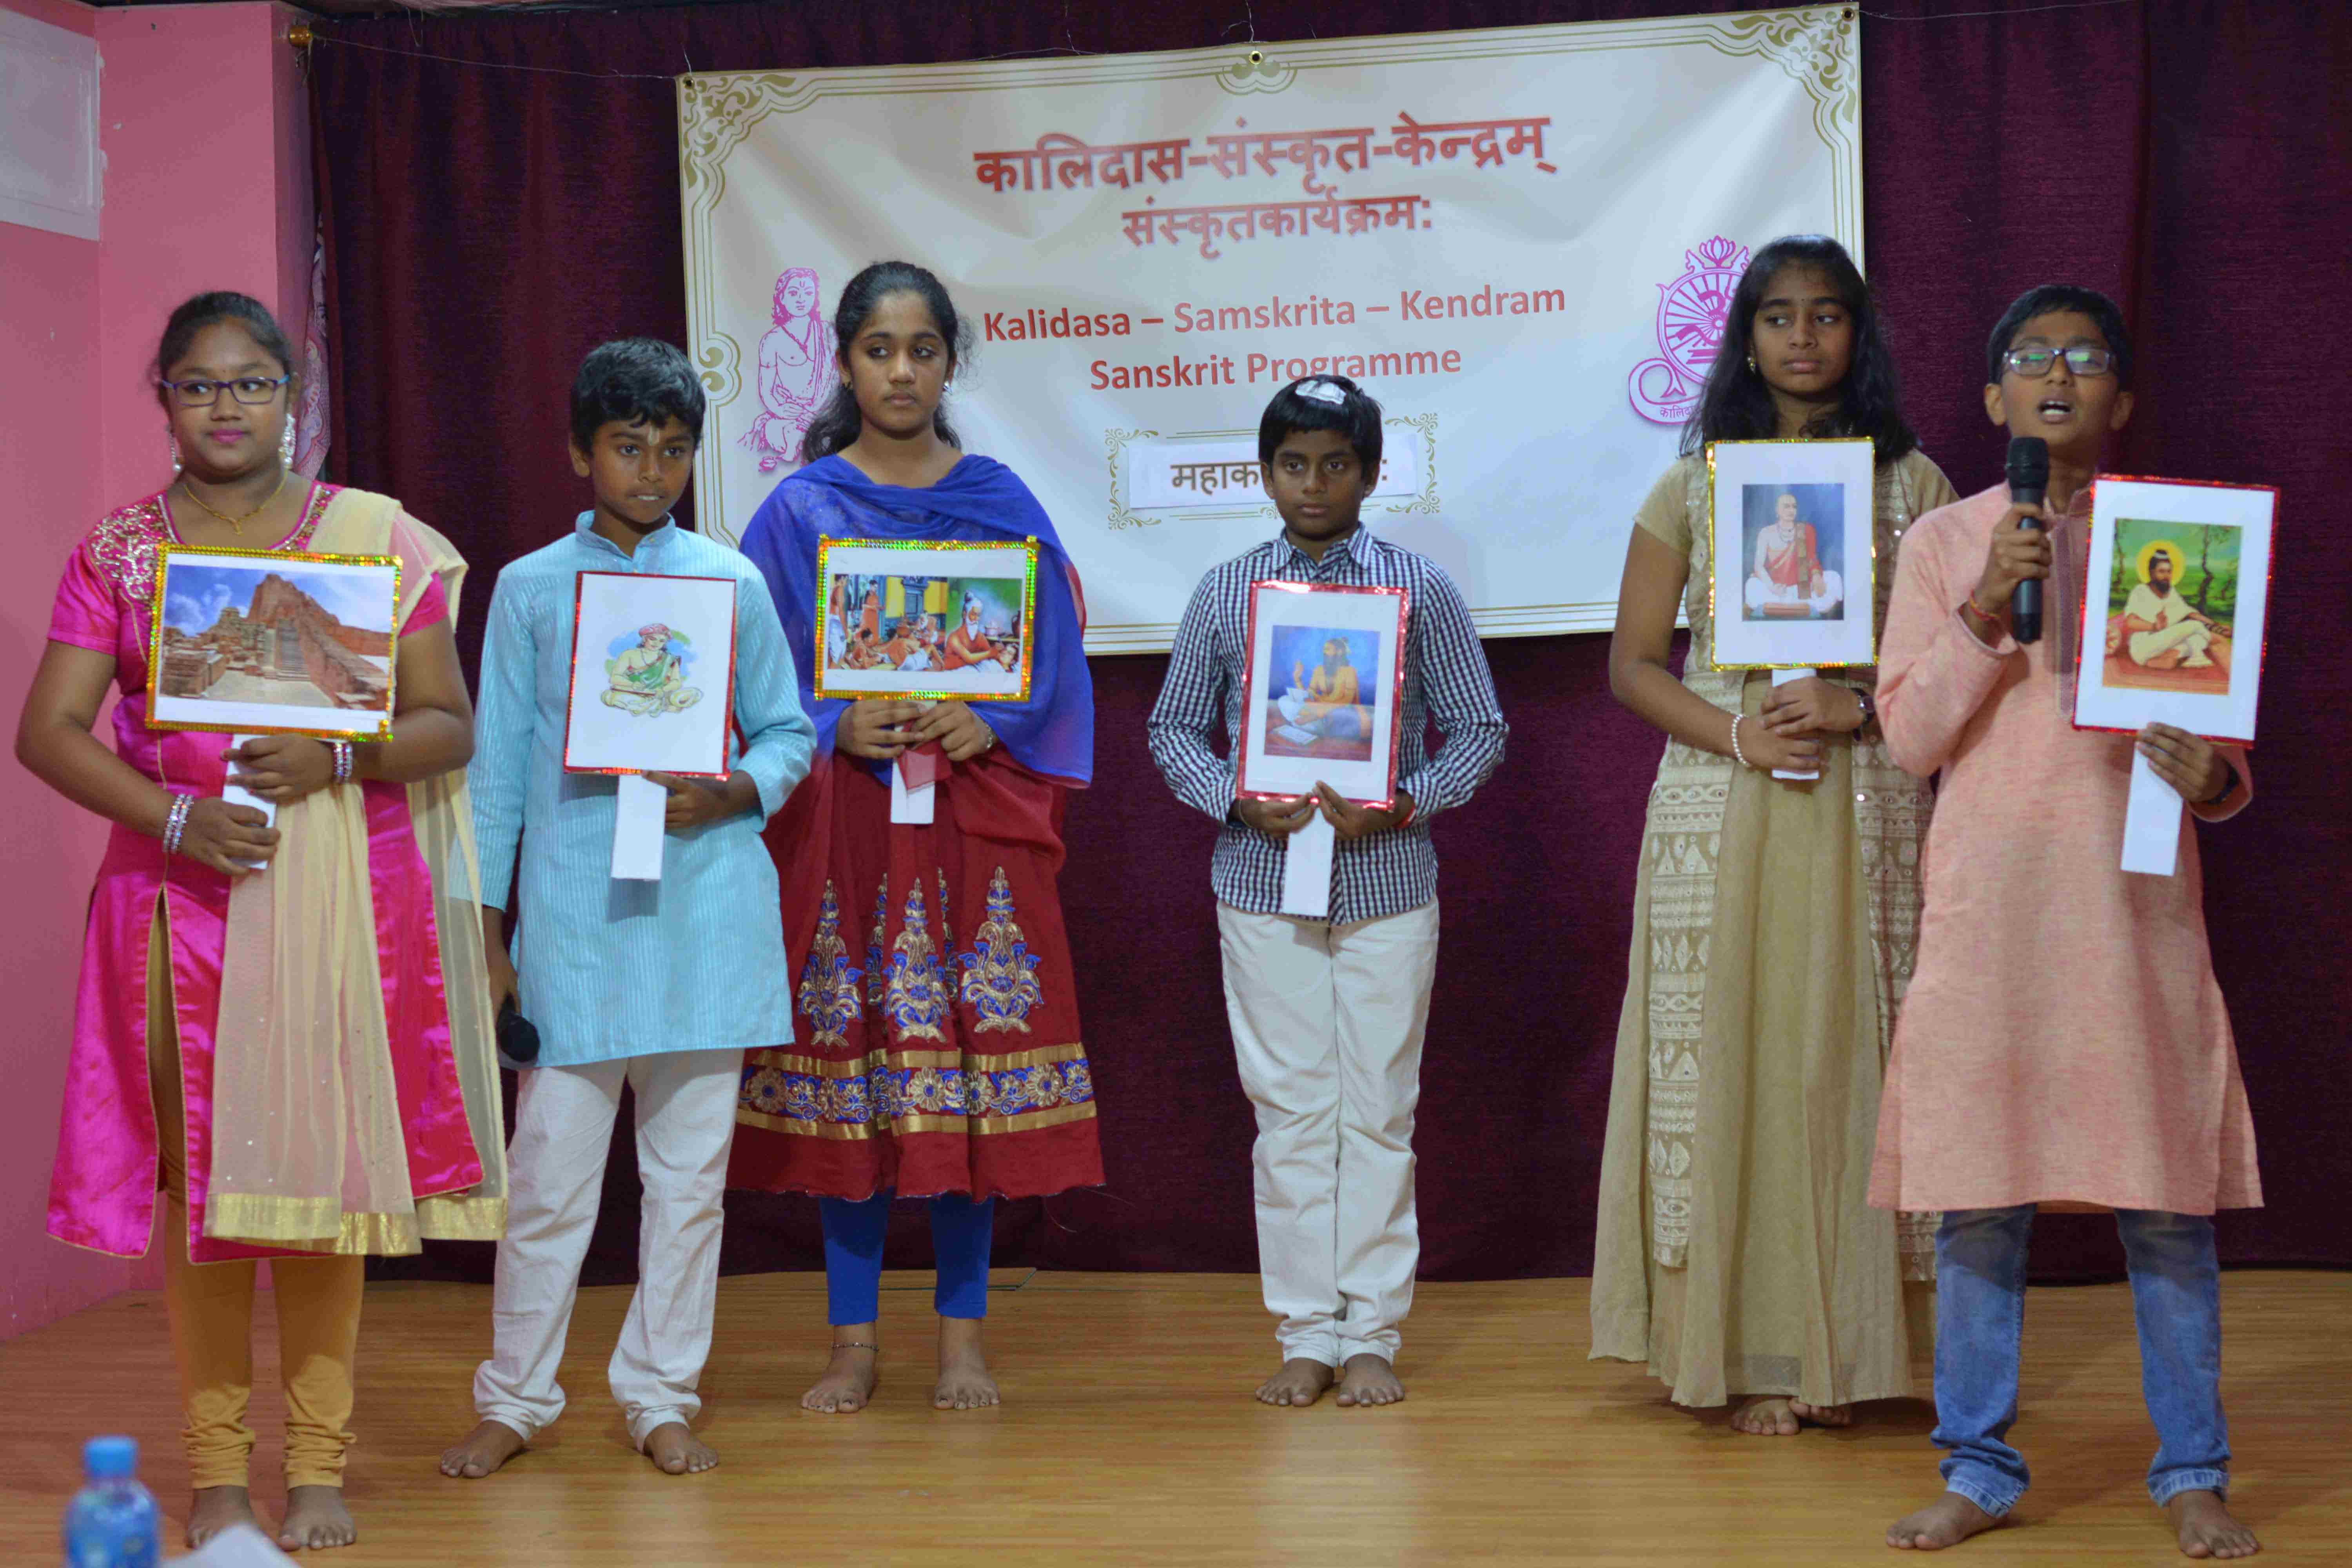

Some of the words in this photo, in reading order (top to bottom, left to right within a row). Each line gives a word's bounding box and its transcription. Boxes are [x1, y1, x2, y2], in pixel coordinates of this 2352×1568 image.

[984, 307, 1130, 341] Kalidasa
[1174, 296, 1355, 333] Samskrita
[1401, 285, 1565, 321] Kendram
[1091, 355, 1234, 390] Sanskrit
